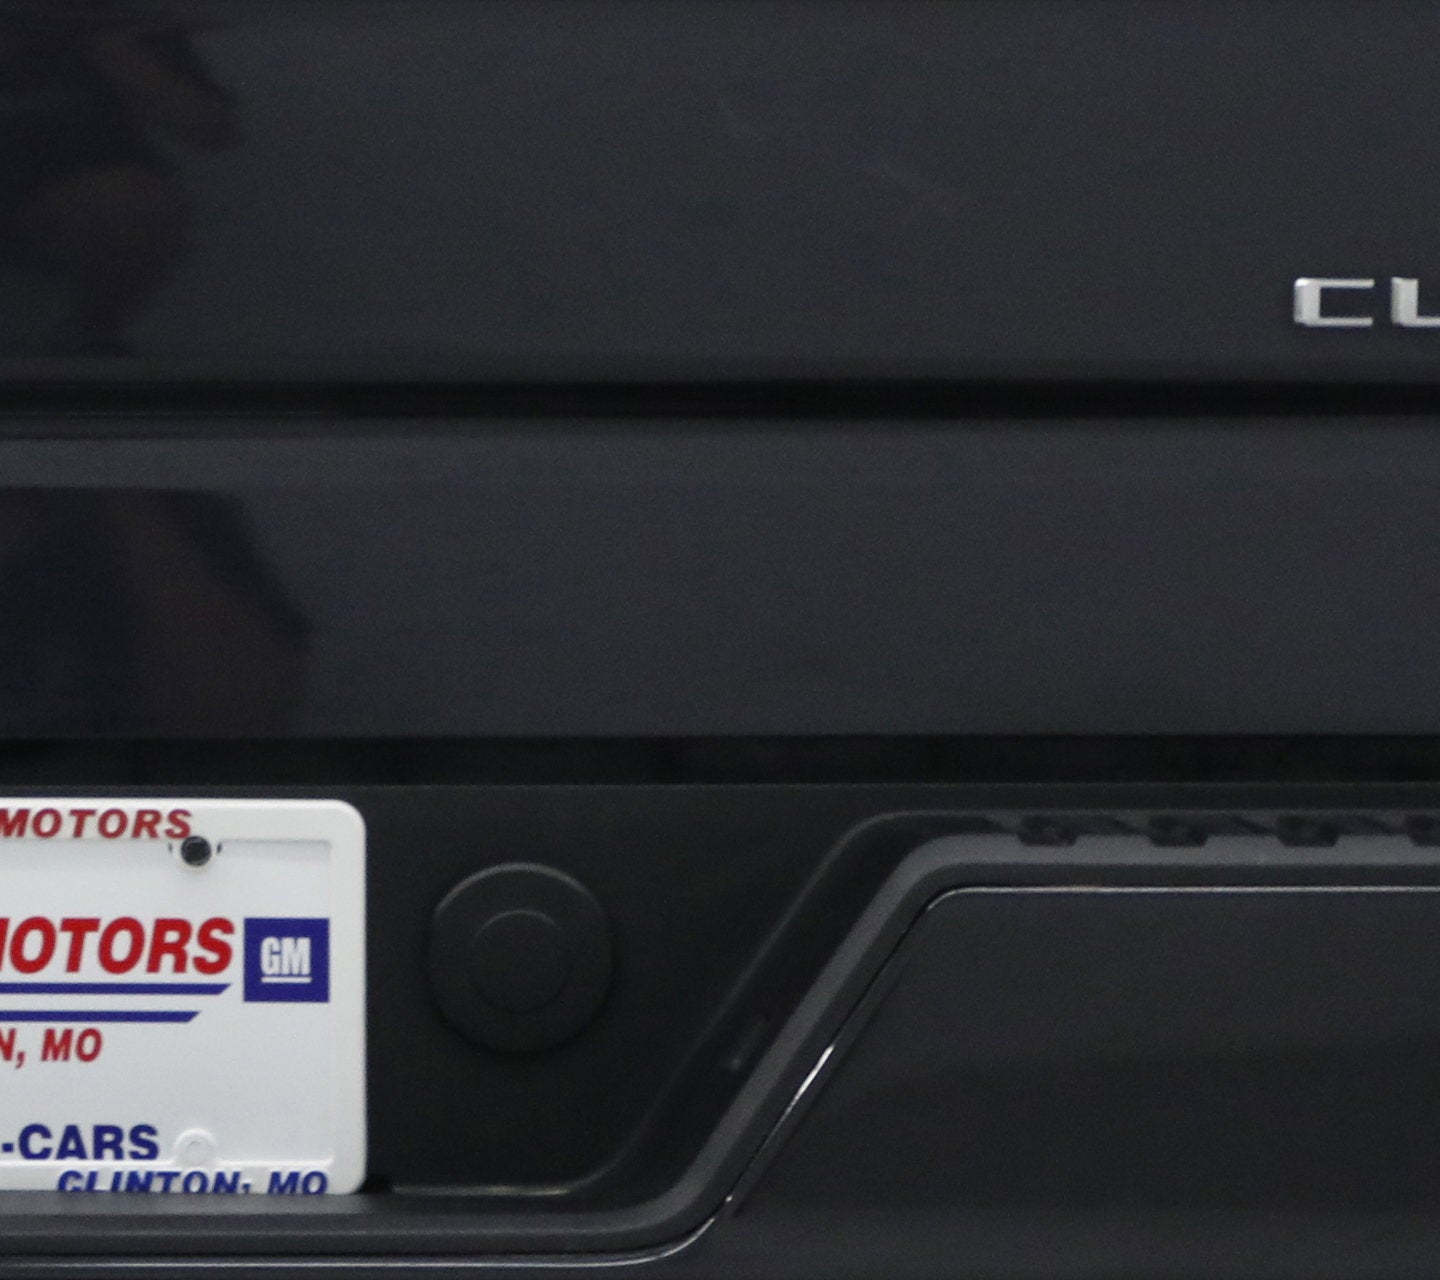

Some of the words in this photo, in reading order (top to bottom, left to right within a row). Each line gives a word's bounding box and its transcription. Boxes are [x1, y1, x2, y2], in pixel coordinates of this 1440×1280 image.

[259, 935, 313, 977] GM
[40, 1027, 104, 1063] MO
[266, 1170, 329, 1196] MO
